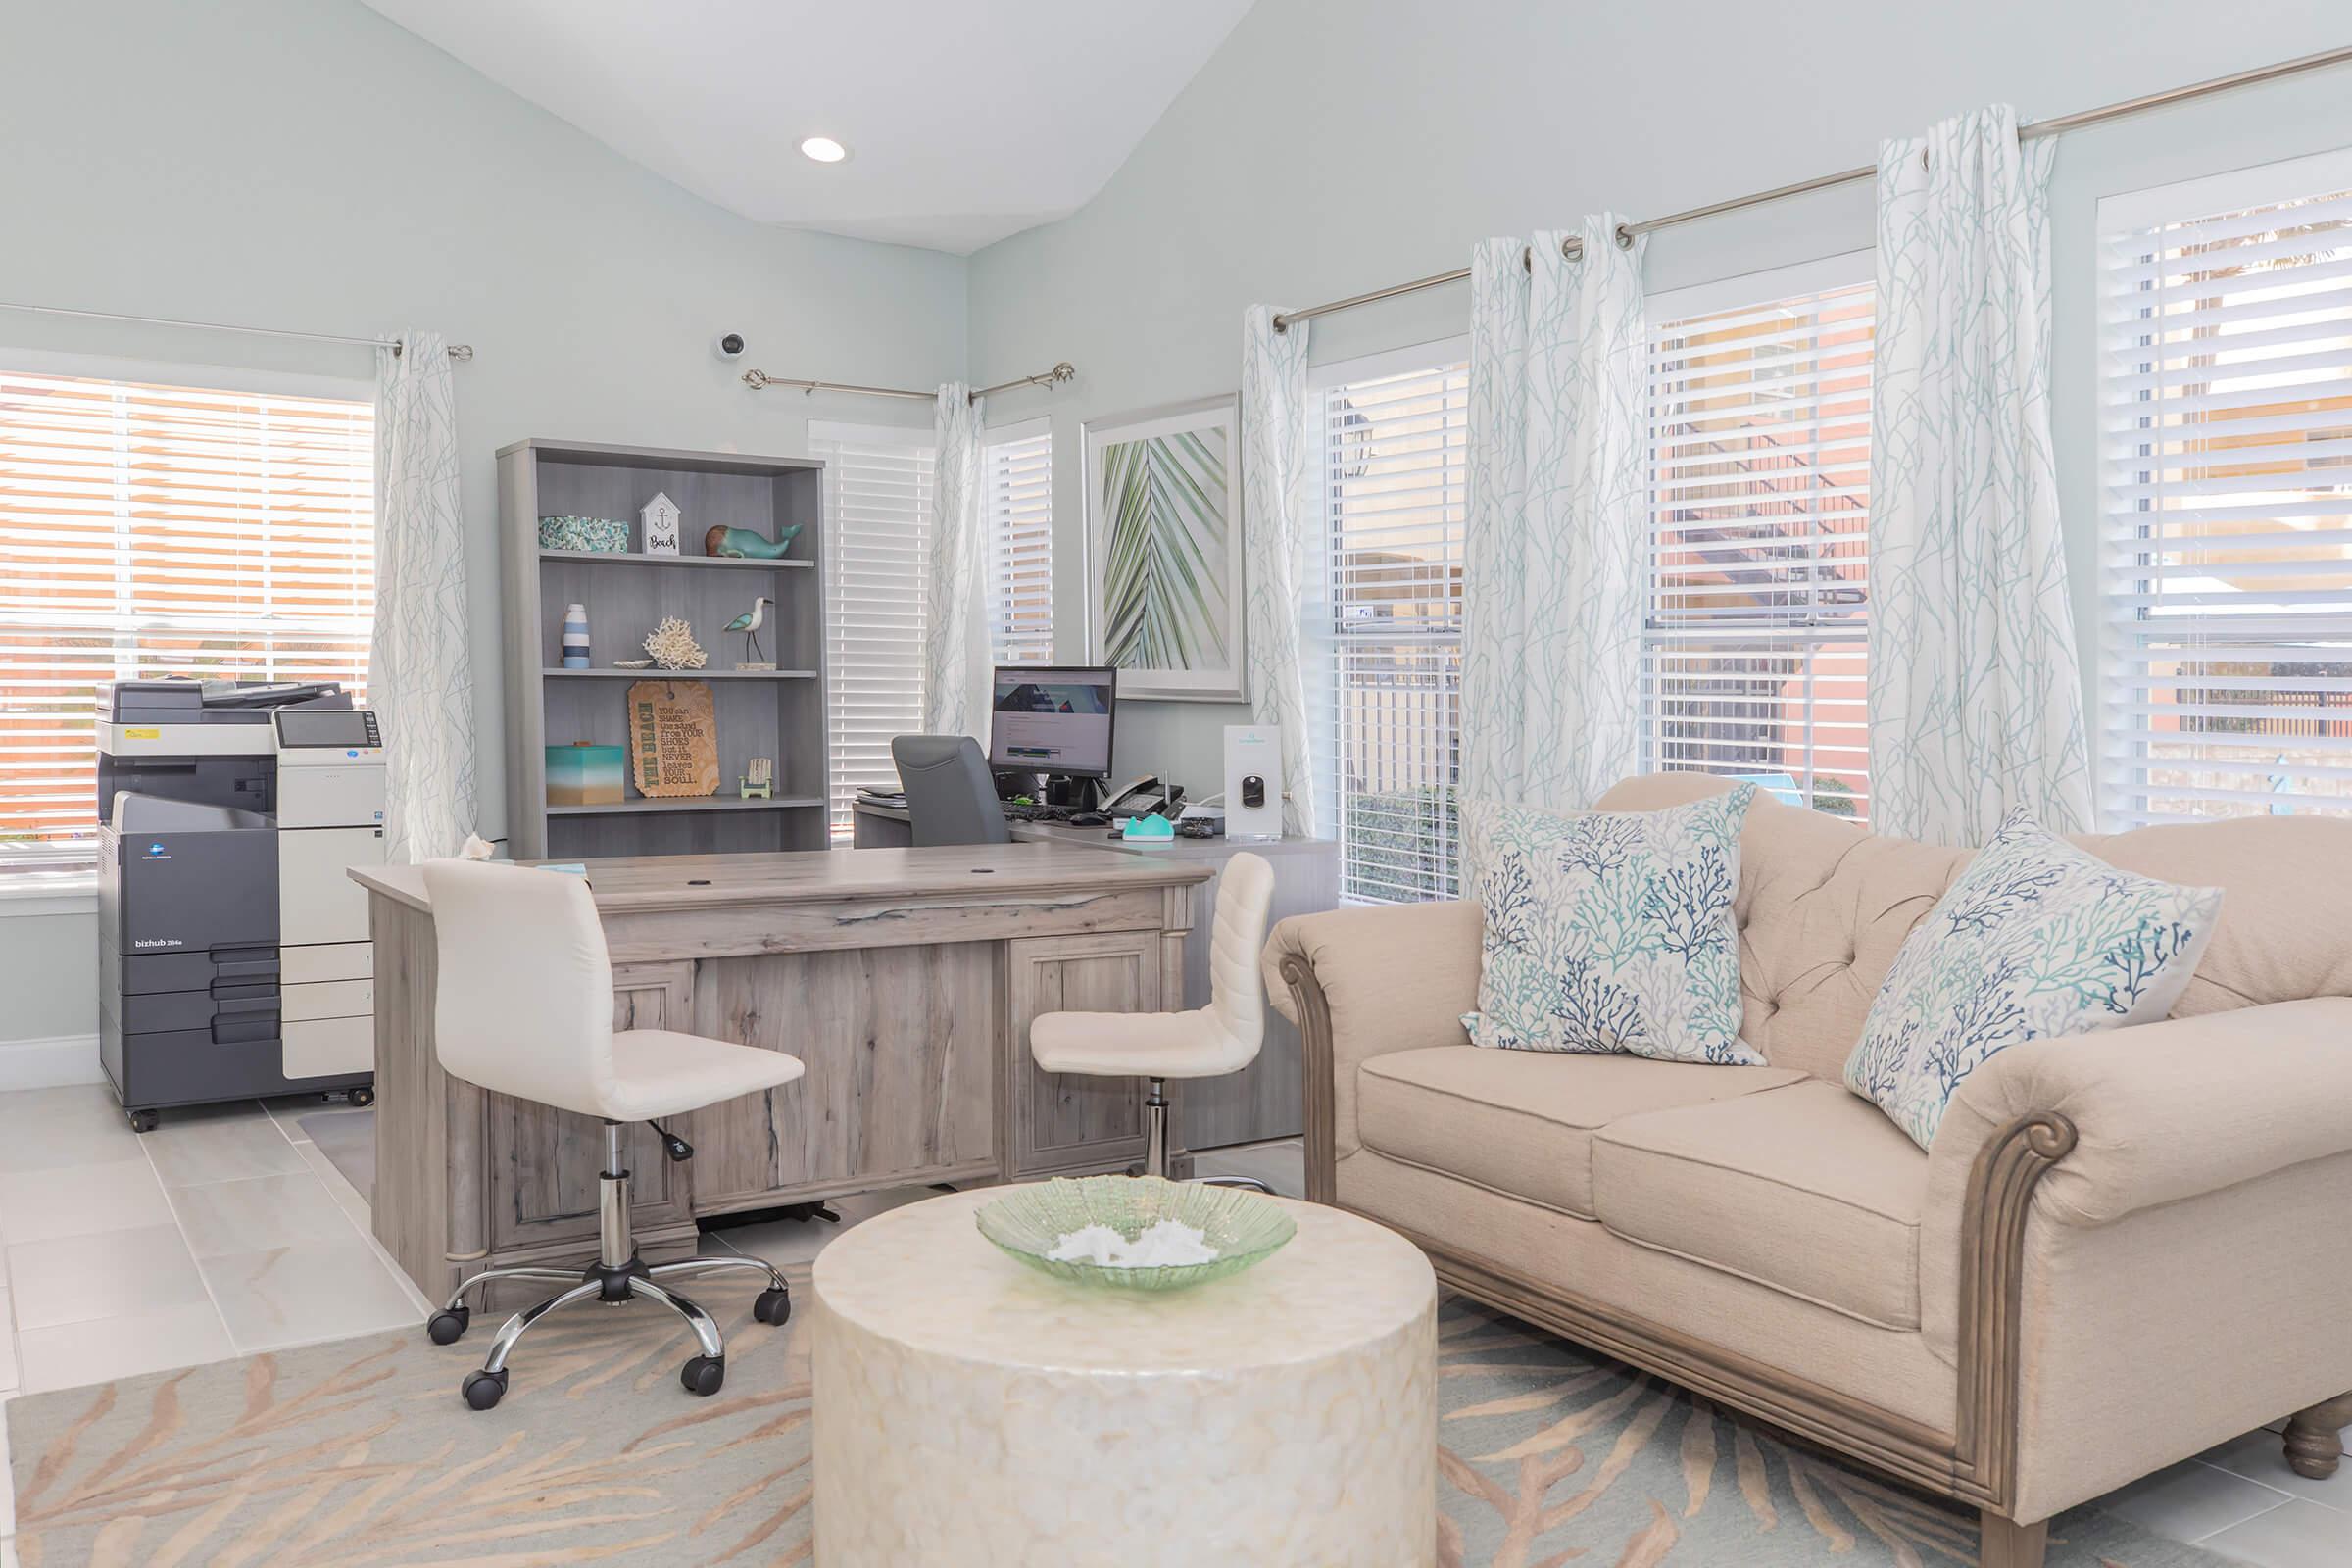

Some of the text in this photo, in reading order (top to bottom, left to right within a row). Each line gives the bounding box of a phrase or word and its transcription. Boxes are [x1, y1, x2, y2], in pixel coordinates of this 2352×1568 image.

[650, 534, 676, 549] Beach
[659, 707, 674, 715] YOU
[682, 728, 704, 737] YOUR
[638, 702, 660, 788] THE BEACH
[661, 737, 690, 746] SHOES
[664, 773, 697, 784] soul.
[135, 938, 167, 948] bizhub
